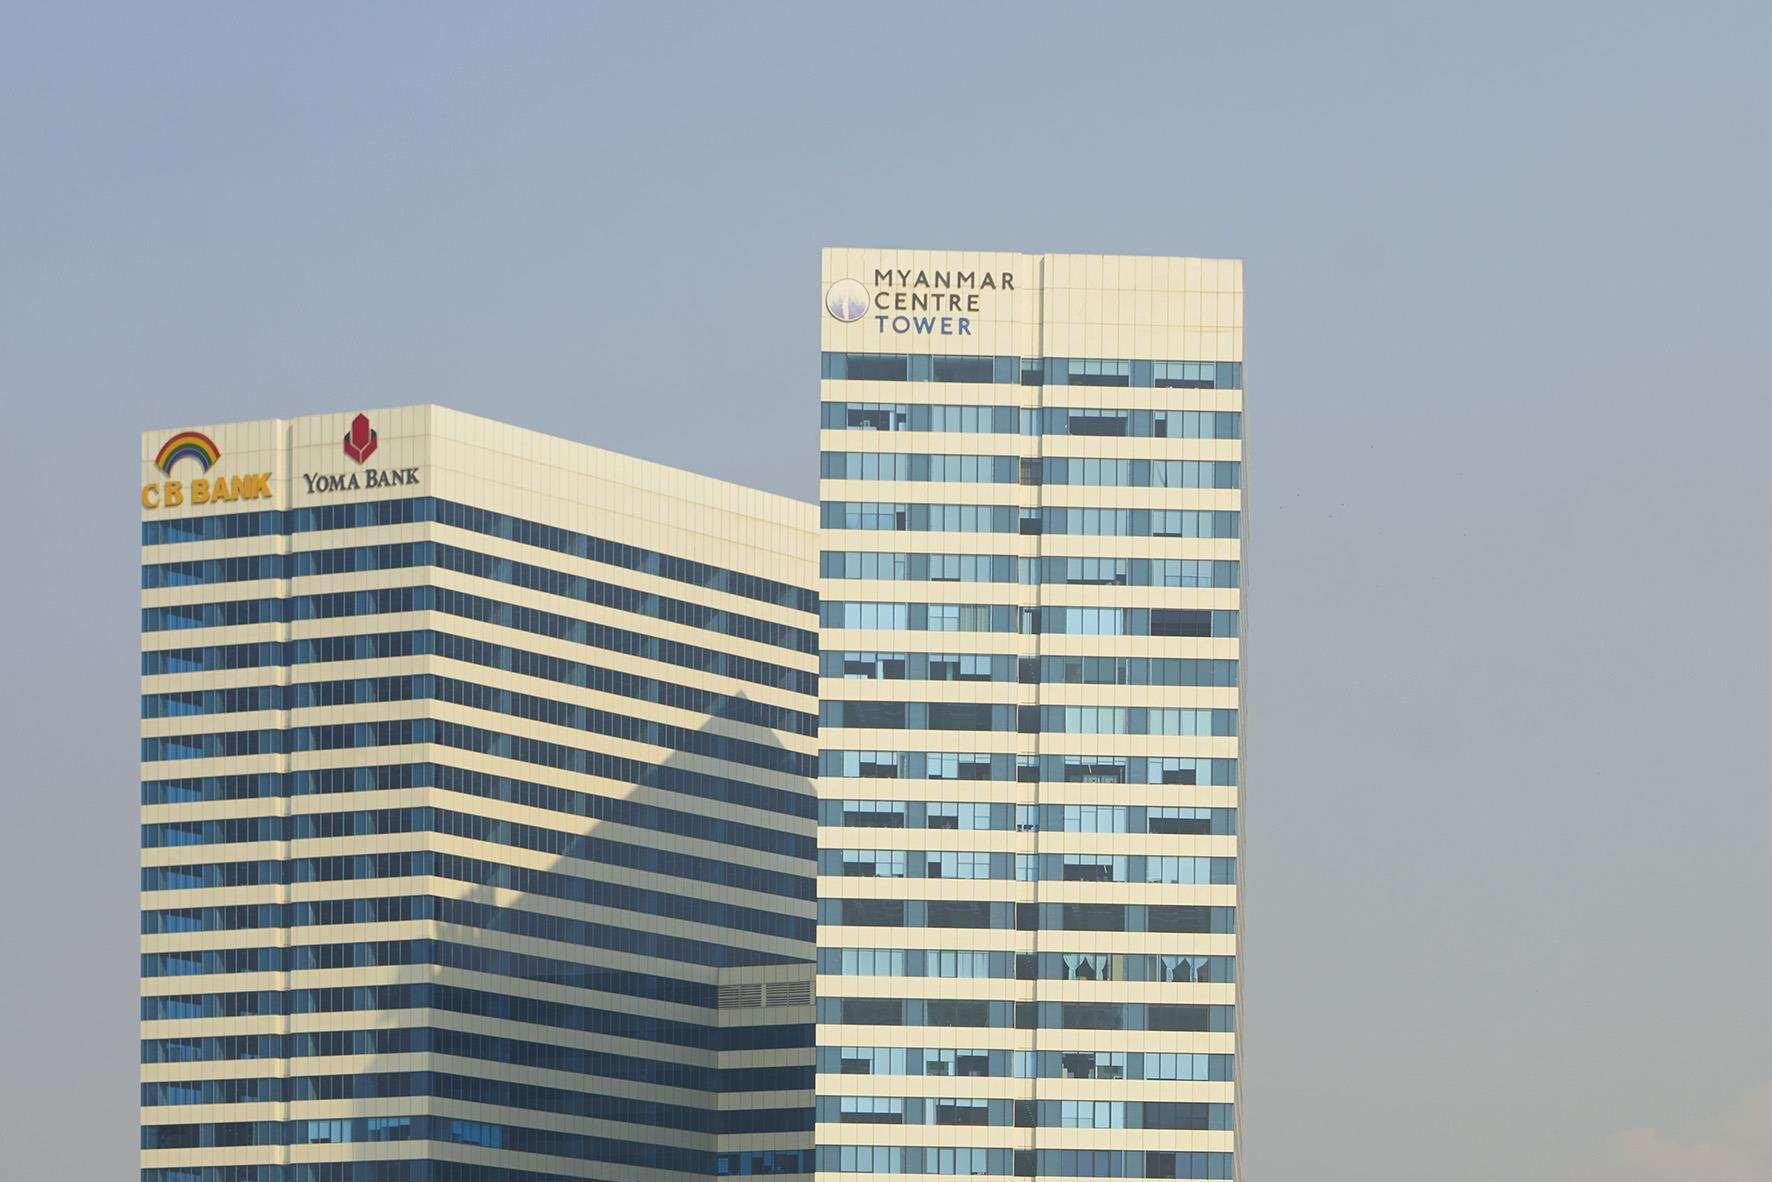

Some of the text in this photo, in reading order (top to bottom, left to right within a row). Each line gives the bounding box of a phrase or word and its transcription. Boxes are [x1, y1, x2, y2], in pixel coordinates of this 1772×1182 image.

[874, 269, 1015, 290] MYANMAR
[874, 292, 979, 312] CENTRE
[875, 315, 972, 336] TOWER
[141, 472, 273, 509] CB BANK
[303, 467, 420, 494] YOMA BANK
